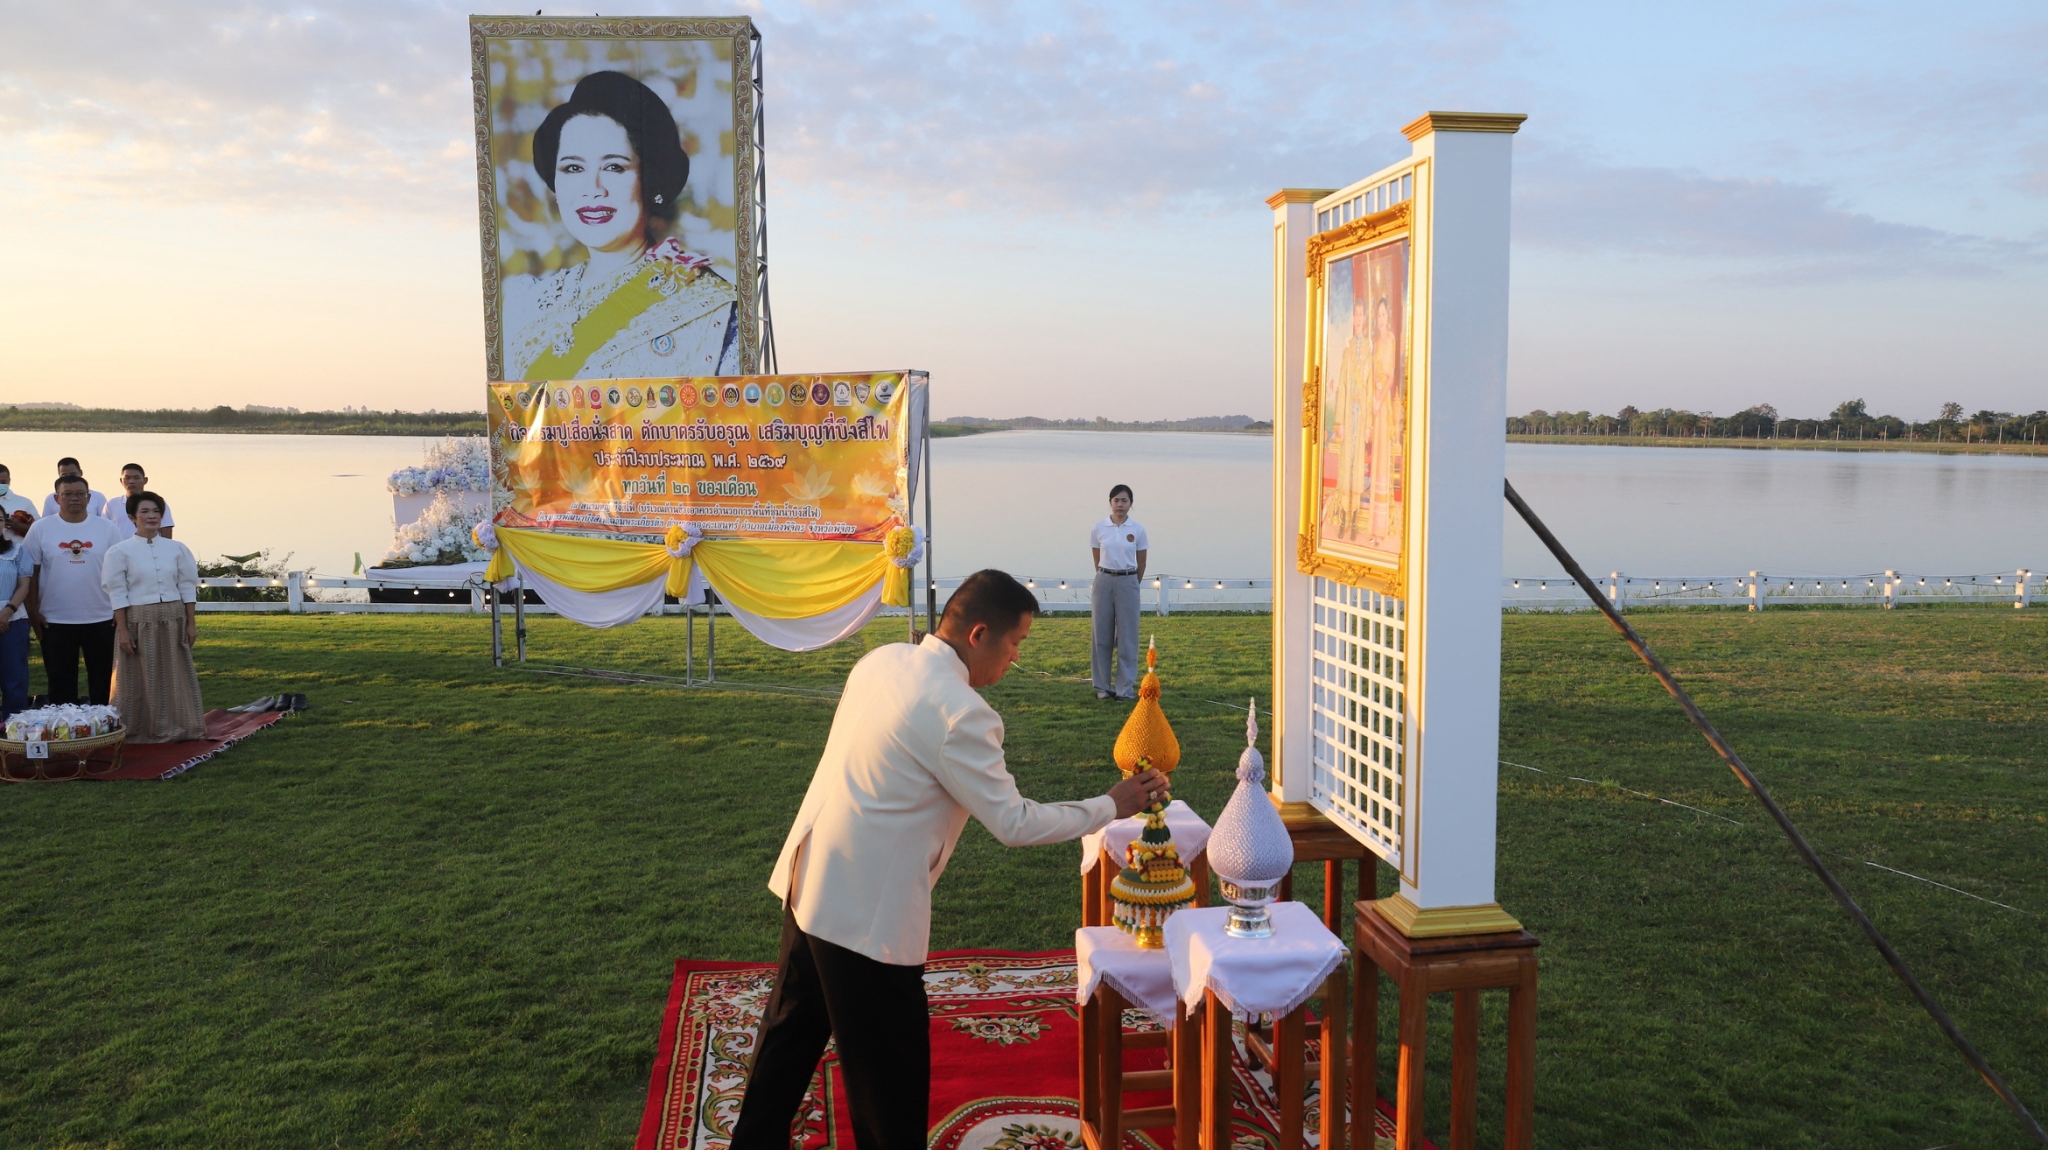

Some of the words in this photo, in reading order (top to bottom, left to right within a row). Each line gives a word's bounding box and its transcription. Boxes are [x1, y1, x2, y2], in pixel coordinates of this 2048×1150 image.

[509, 414, 634, 447] กิจรมปูเสื่อนั่งสาด
[641, 418, 750, 447] ตักบาตรรับอรุณ
[758, 412, 890, 448] เสริมบุญที่บึงสีไฟ
[594, 447, 705, 468] ประจำปีงบประมาณ
[712, 452, 741, 468] พ.ศ.
[746, 454, 787, 469] ๒๕๖๙
[621, 470, 667, 499] ทุกวันที่
[697, 474, 757, 496] ของเดือน
[35, 745, 41, 754] 1
